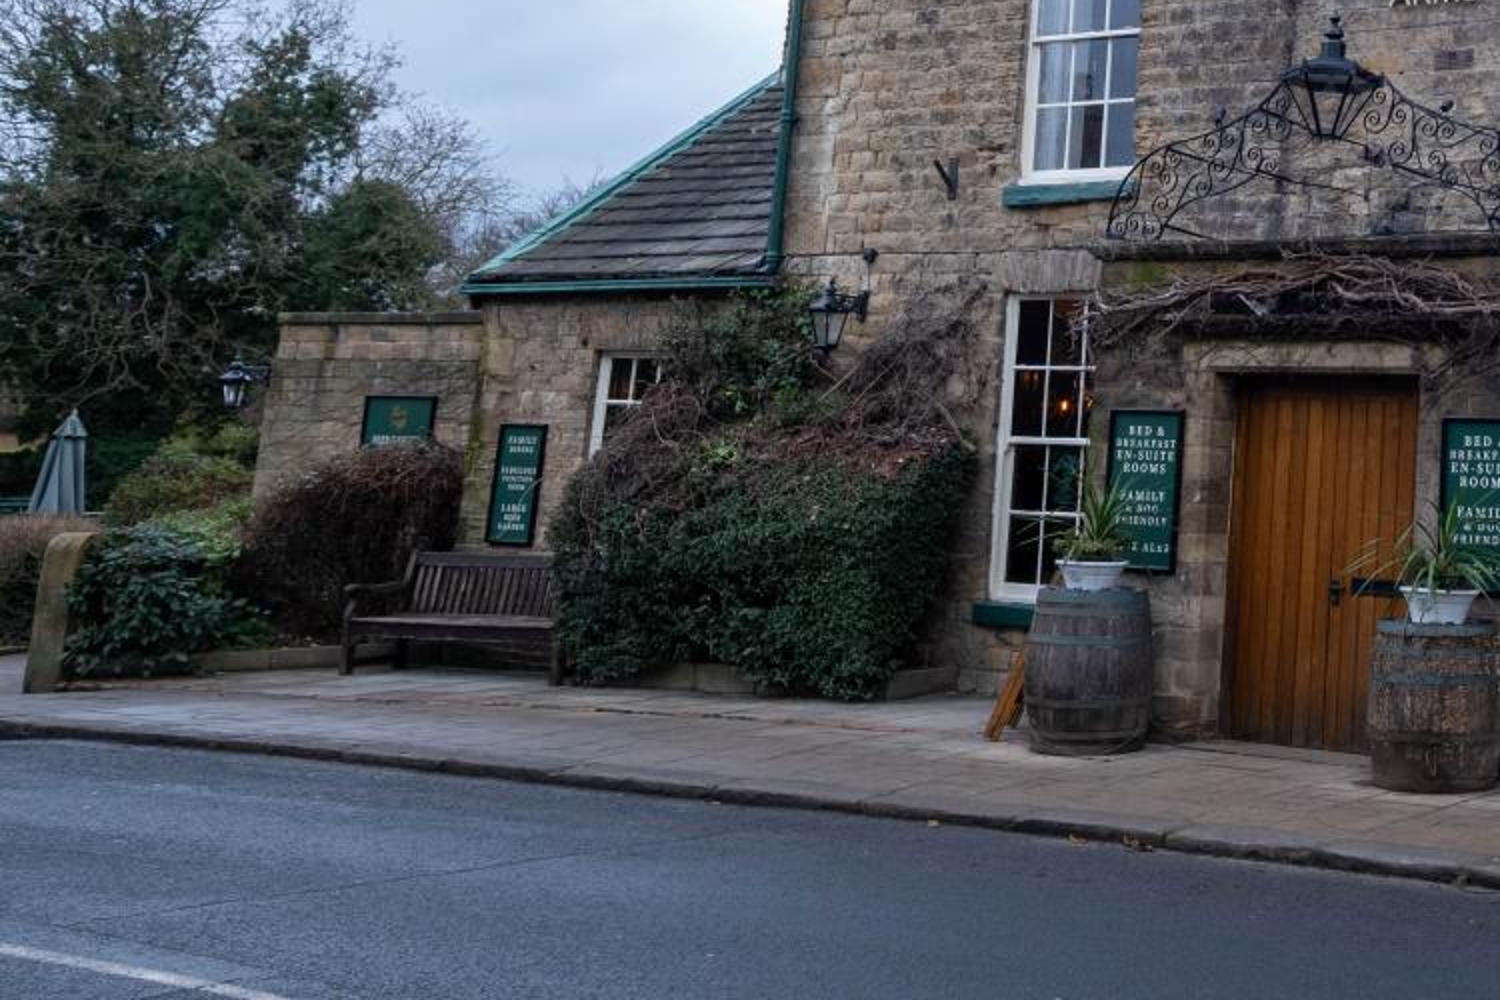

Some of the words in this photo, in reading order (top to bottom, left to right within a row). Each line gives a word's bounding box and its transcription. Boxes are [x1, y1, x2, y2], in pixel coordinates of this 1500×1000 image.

[1128, 425, 1152, 436] BED
[1157, 425, 1165, 436] &
[1115, 437, 1177, 449] BREAKFAST
[1463, 435, 1493, 447] BED
[1116, 450, 1175, 462] EN-SUITE
[1122, 462, 1167, 474] ROOMS
[1119, 490, 1166, 503] FAMILY
